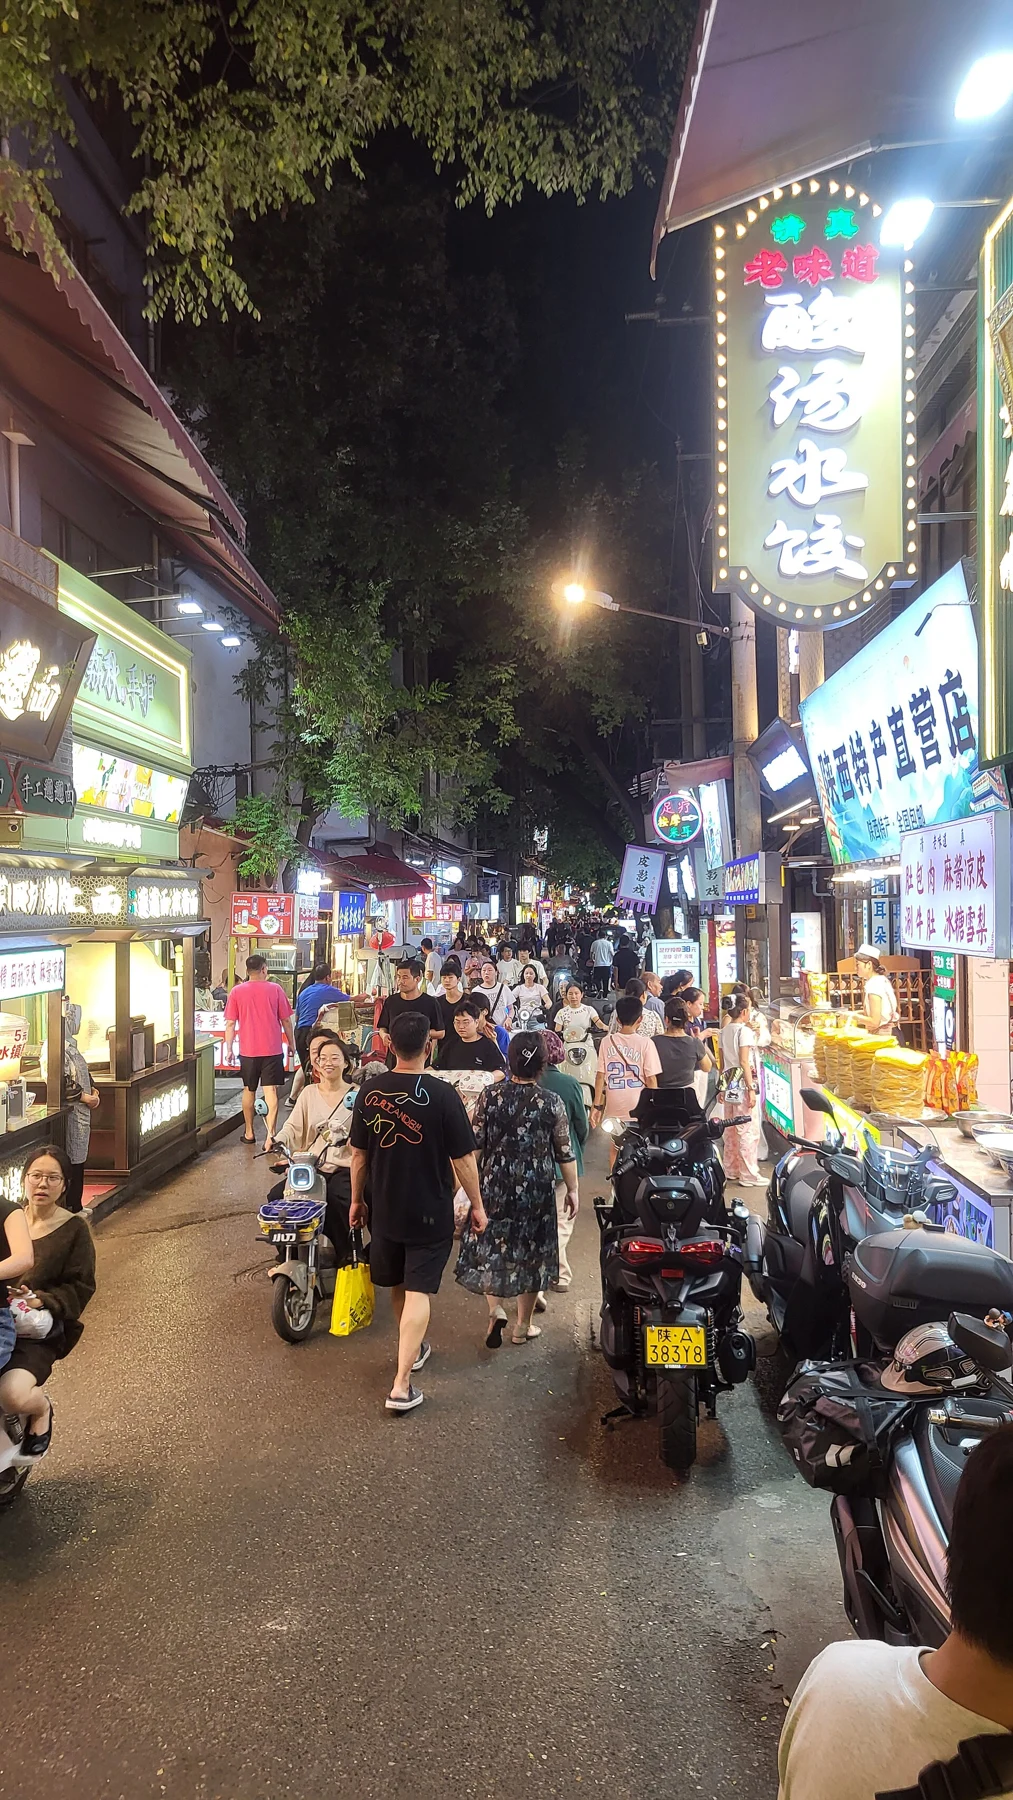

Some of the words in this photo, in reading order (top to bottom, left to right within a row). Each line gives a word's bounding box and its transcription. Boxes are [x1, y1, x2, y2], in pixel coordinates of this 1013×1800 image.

[770, 207, 859, 244] 清真
[743, 245, 881, 287] 老味道
[761, 286, 871, 582] 酸汤水饺
[817, 668, 977, 804] 陕西特产直营店
[658, 813, 681, 828] 按摩
[660, 800, 691, 815] 足疗
[669, 825, 692, 838] 采耳
[632, 854, 650, 898] 皮影戏
[705, 862, 720, 897] 影戏
[905, 858, 936, 896] 肚包肉
[943, 849, 988, 892] 麻酱凉皮
[905, 904, 936, 942] 涮牛肚
[943, 903, 988, 946] 冰糖雪梨
[14, 1029, 27, 1042] 5元
[607, 1044, 641, 1062] JORDAN
[607, 1062, 644, 1090] 23
[657, 1328, 693, 1343] 陕·A
[650, 1345, 703, 1363] 383Y8
